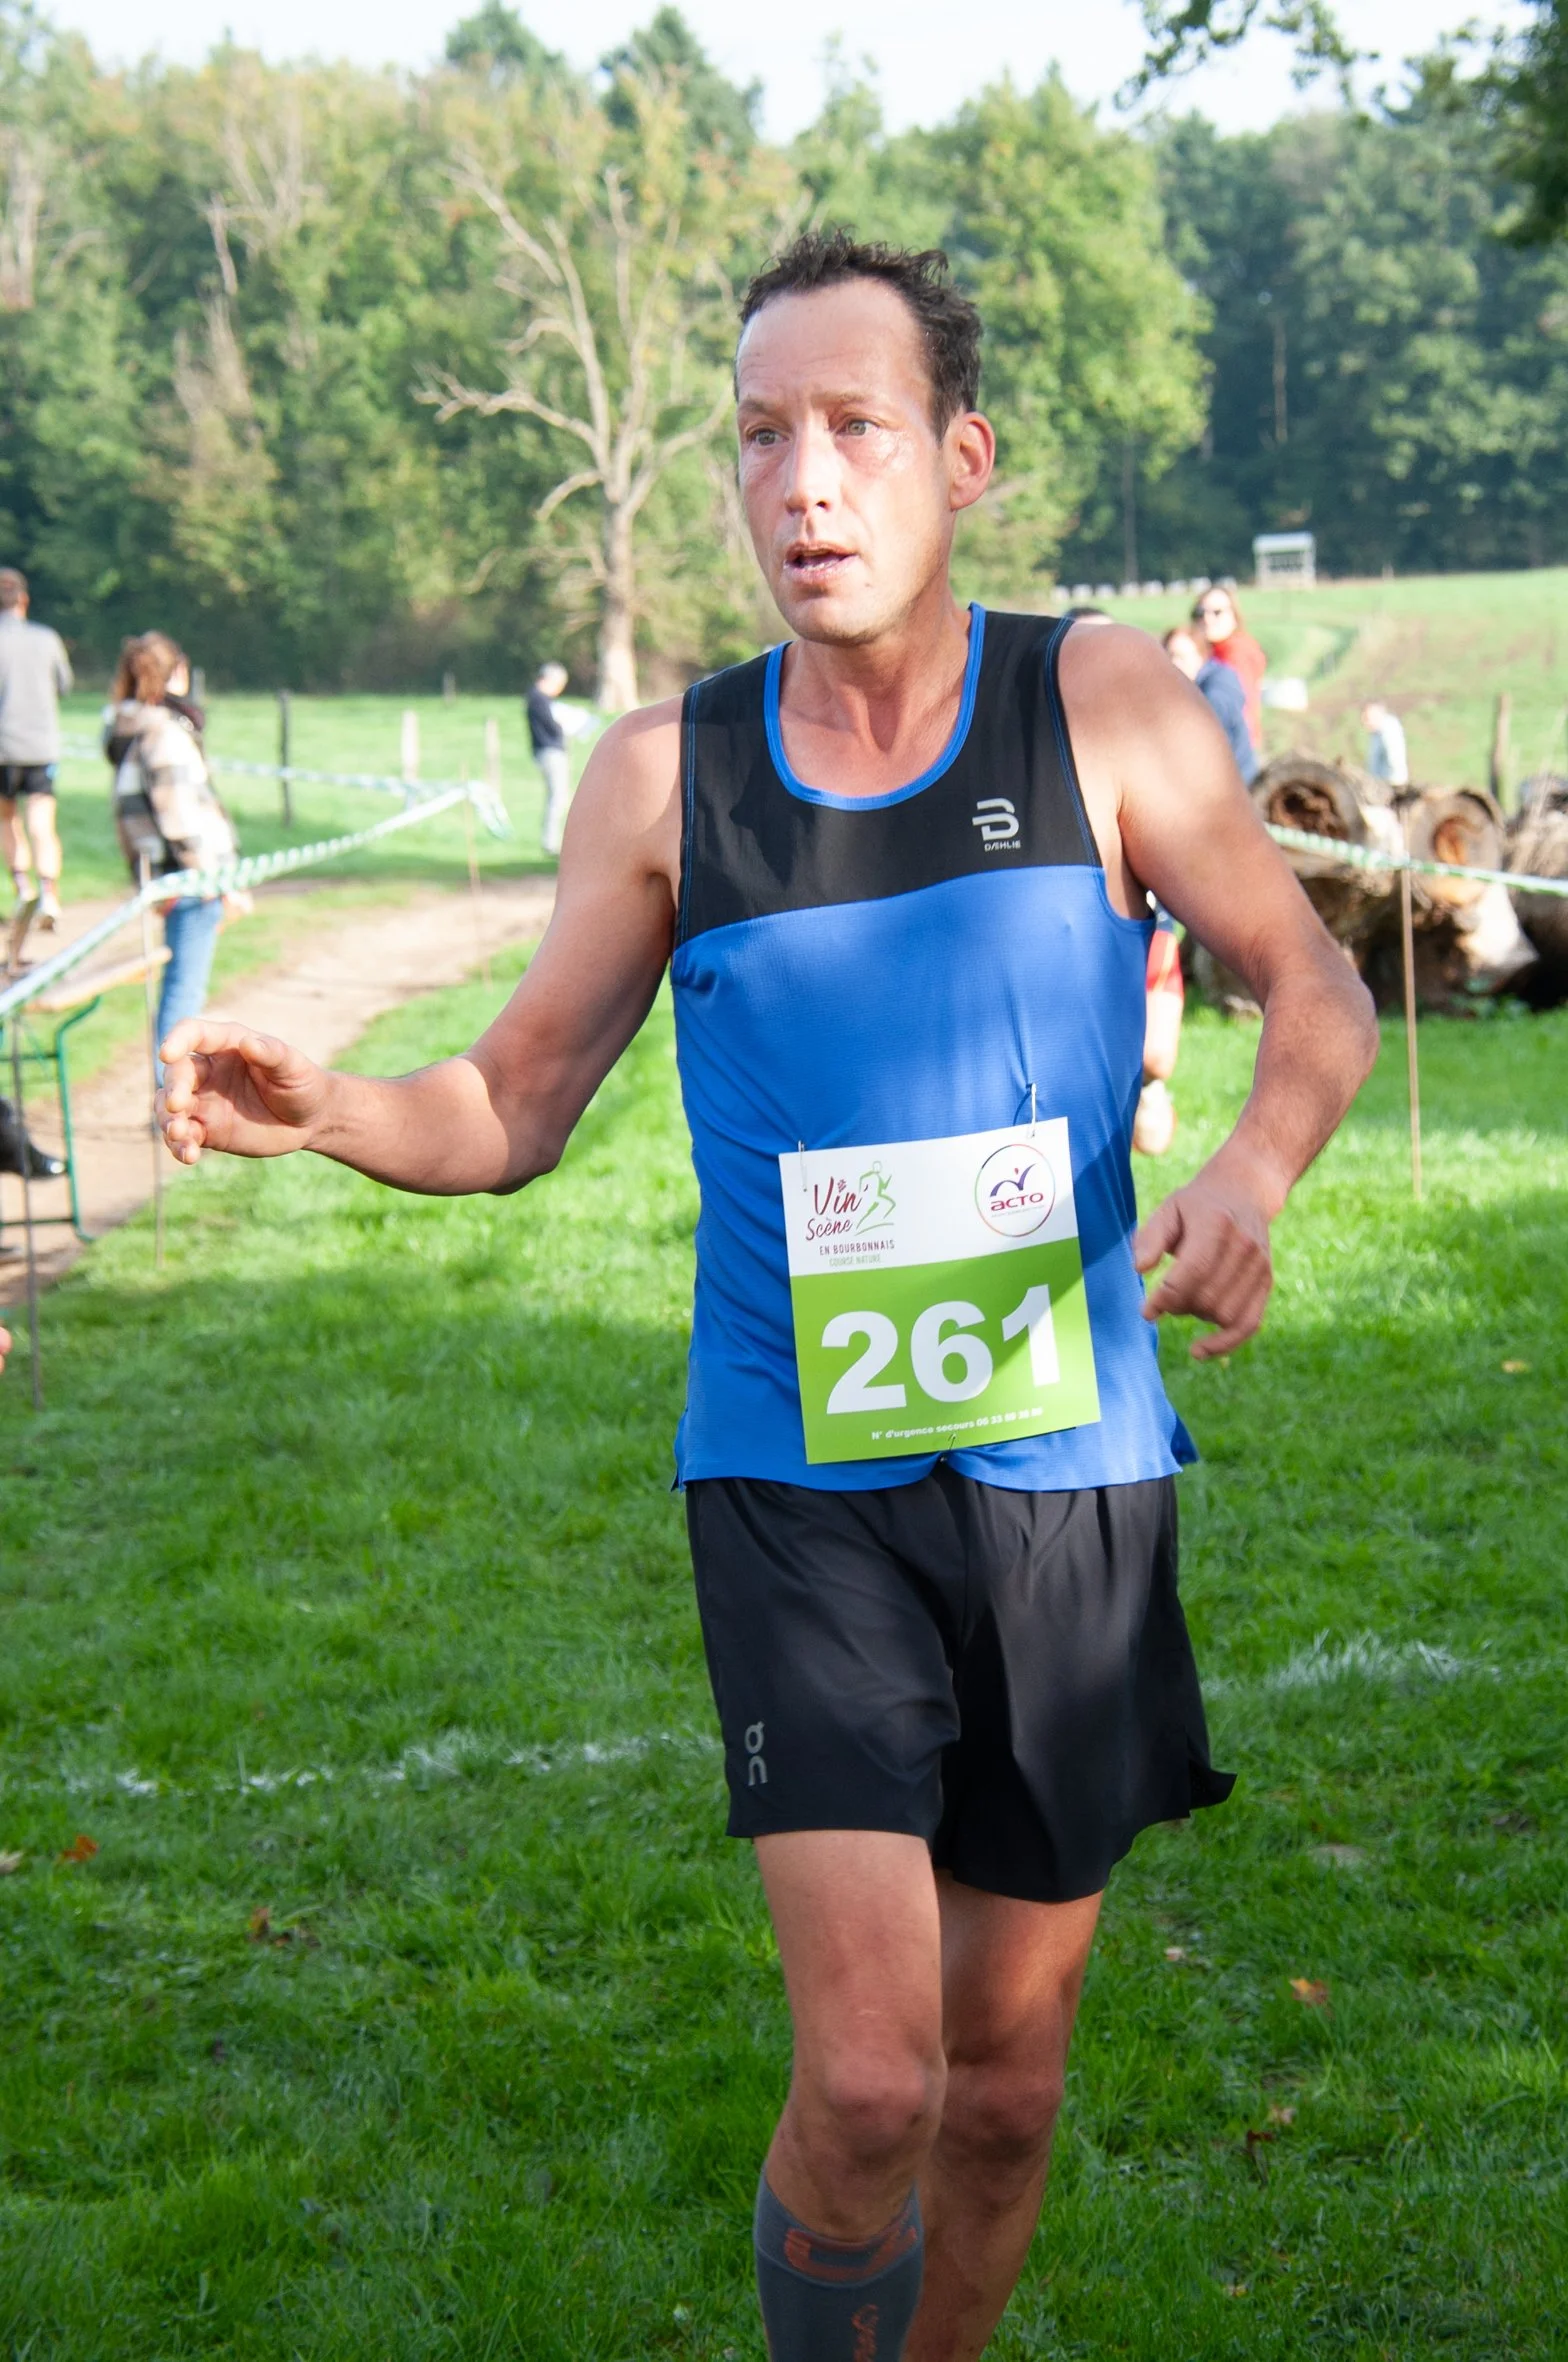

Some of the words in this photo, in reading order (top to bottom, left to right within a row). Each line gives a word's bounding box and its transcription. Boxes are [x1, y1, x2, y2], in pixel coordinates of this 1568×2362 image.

[819, 1245, 830, 1256] EN
[833, 1239, 895, 1255] BOURBONNAIS
[821, 1284, 1061, 1415] 261
[936, 1421, 974, 1434] secours
